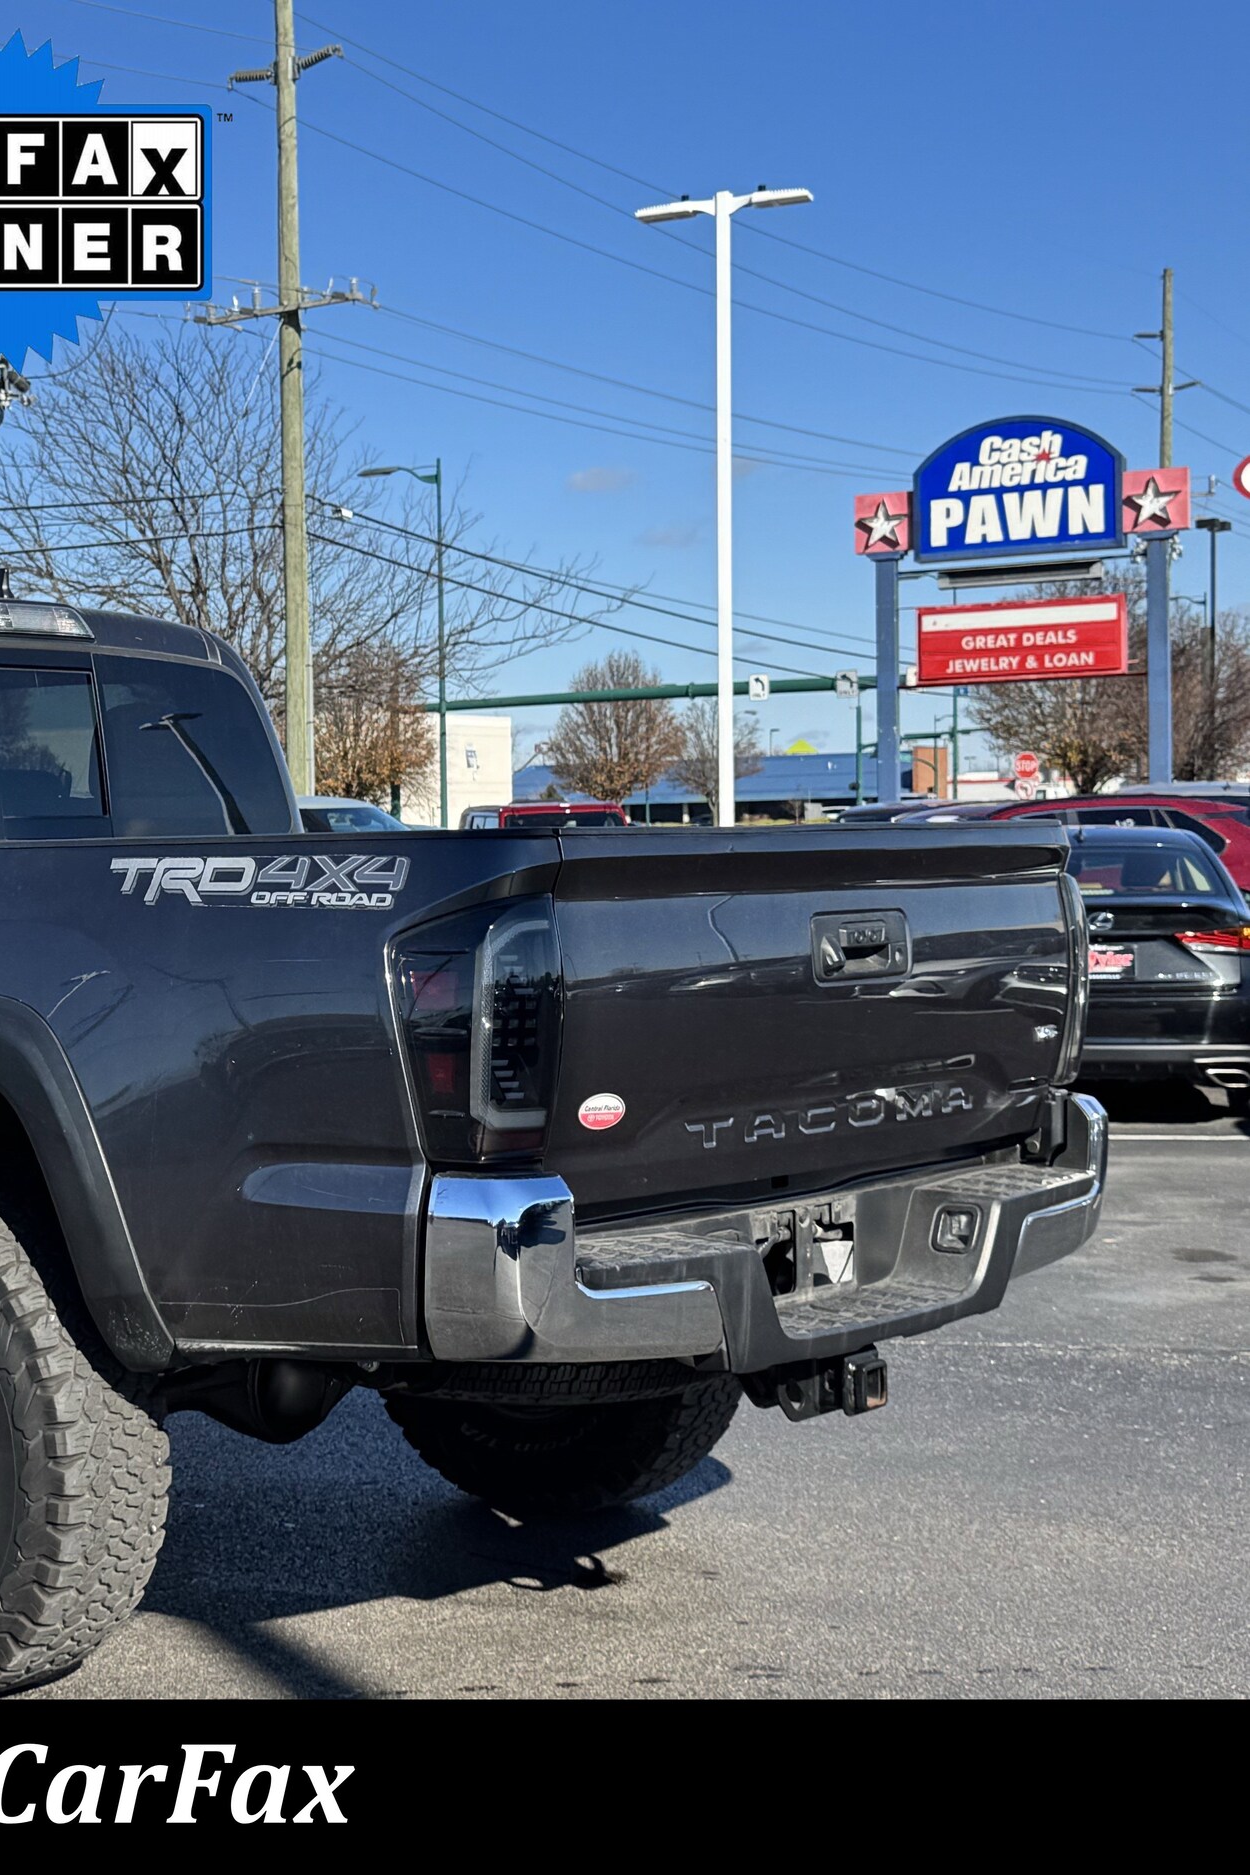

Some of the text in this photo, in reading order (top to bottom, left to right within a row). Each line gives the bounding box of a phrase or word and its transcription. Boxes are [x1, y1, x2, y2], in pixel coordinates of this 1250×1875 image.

[978, 430, 1064, 466] Cash
[948, 454, 1088, 492] America
[930, 483, 1105, 548] PAWN
[961, 629, 1078, 651] GREAT DEALS
[945, 651, 1095, 674] JEWELRY & LOAN
[1016, 759, 1037, 772] STOP
[110, 857, 257, 905] TRD
[250, 891, 394, 909] OFF ROAD
[685, 1085, 973, 1148] TACOMA
